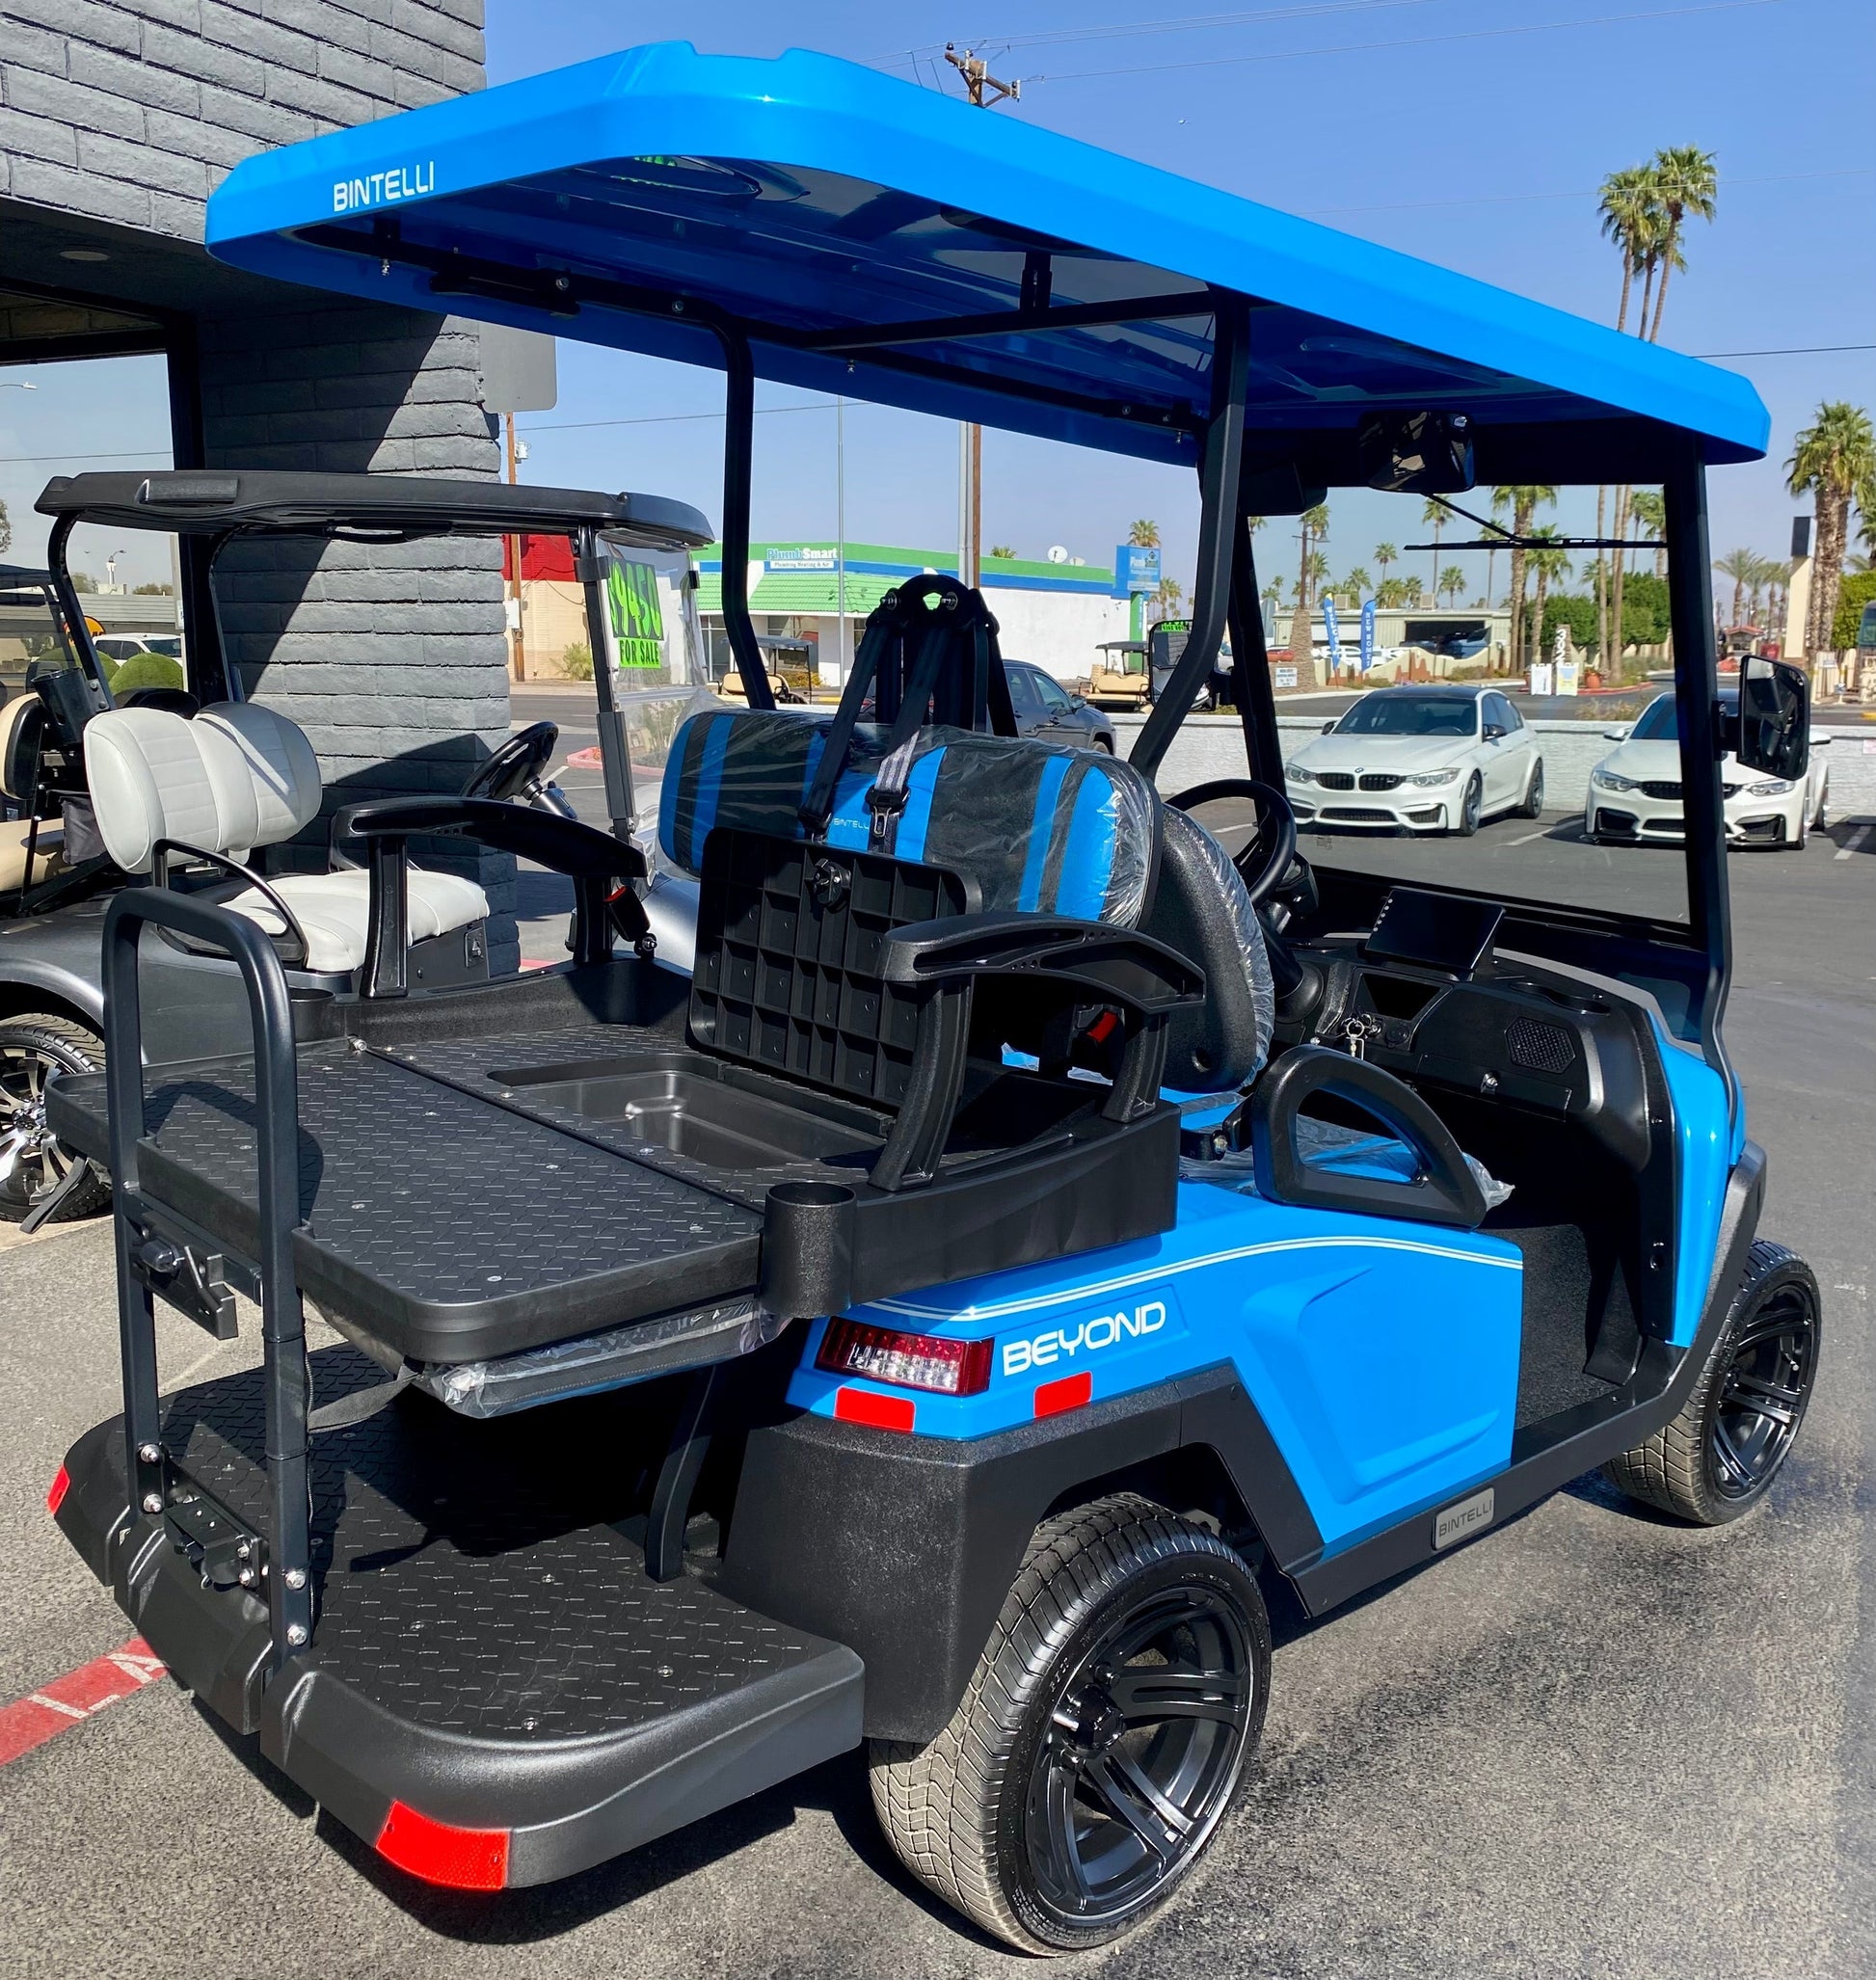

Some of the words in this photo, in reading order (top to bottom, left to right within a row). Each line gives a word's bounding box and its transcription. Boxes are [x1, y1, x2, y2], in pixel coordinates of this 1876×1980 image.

[334, 160, 435, 212] BINTELLI
[766, 548, 838, 560] PlumbSmart
[619, 640, 637, 665] FOR
[639, 641, 659, 665] SALE
[834, 817, 870, 829] BINTELL
[1003, 1301, 1166, 1377] BEYOND
[1438, 1499, 1492, 1537] BINTELLI
